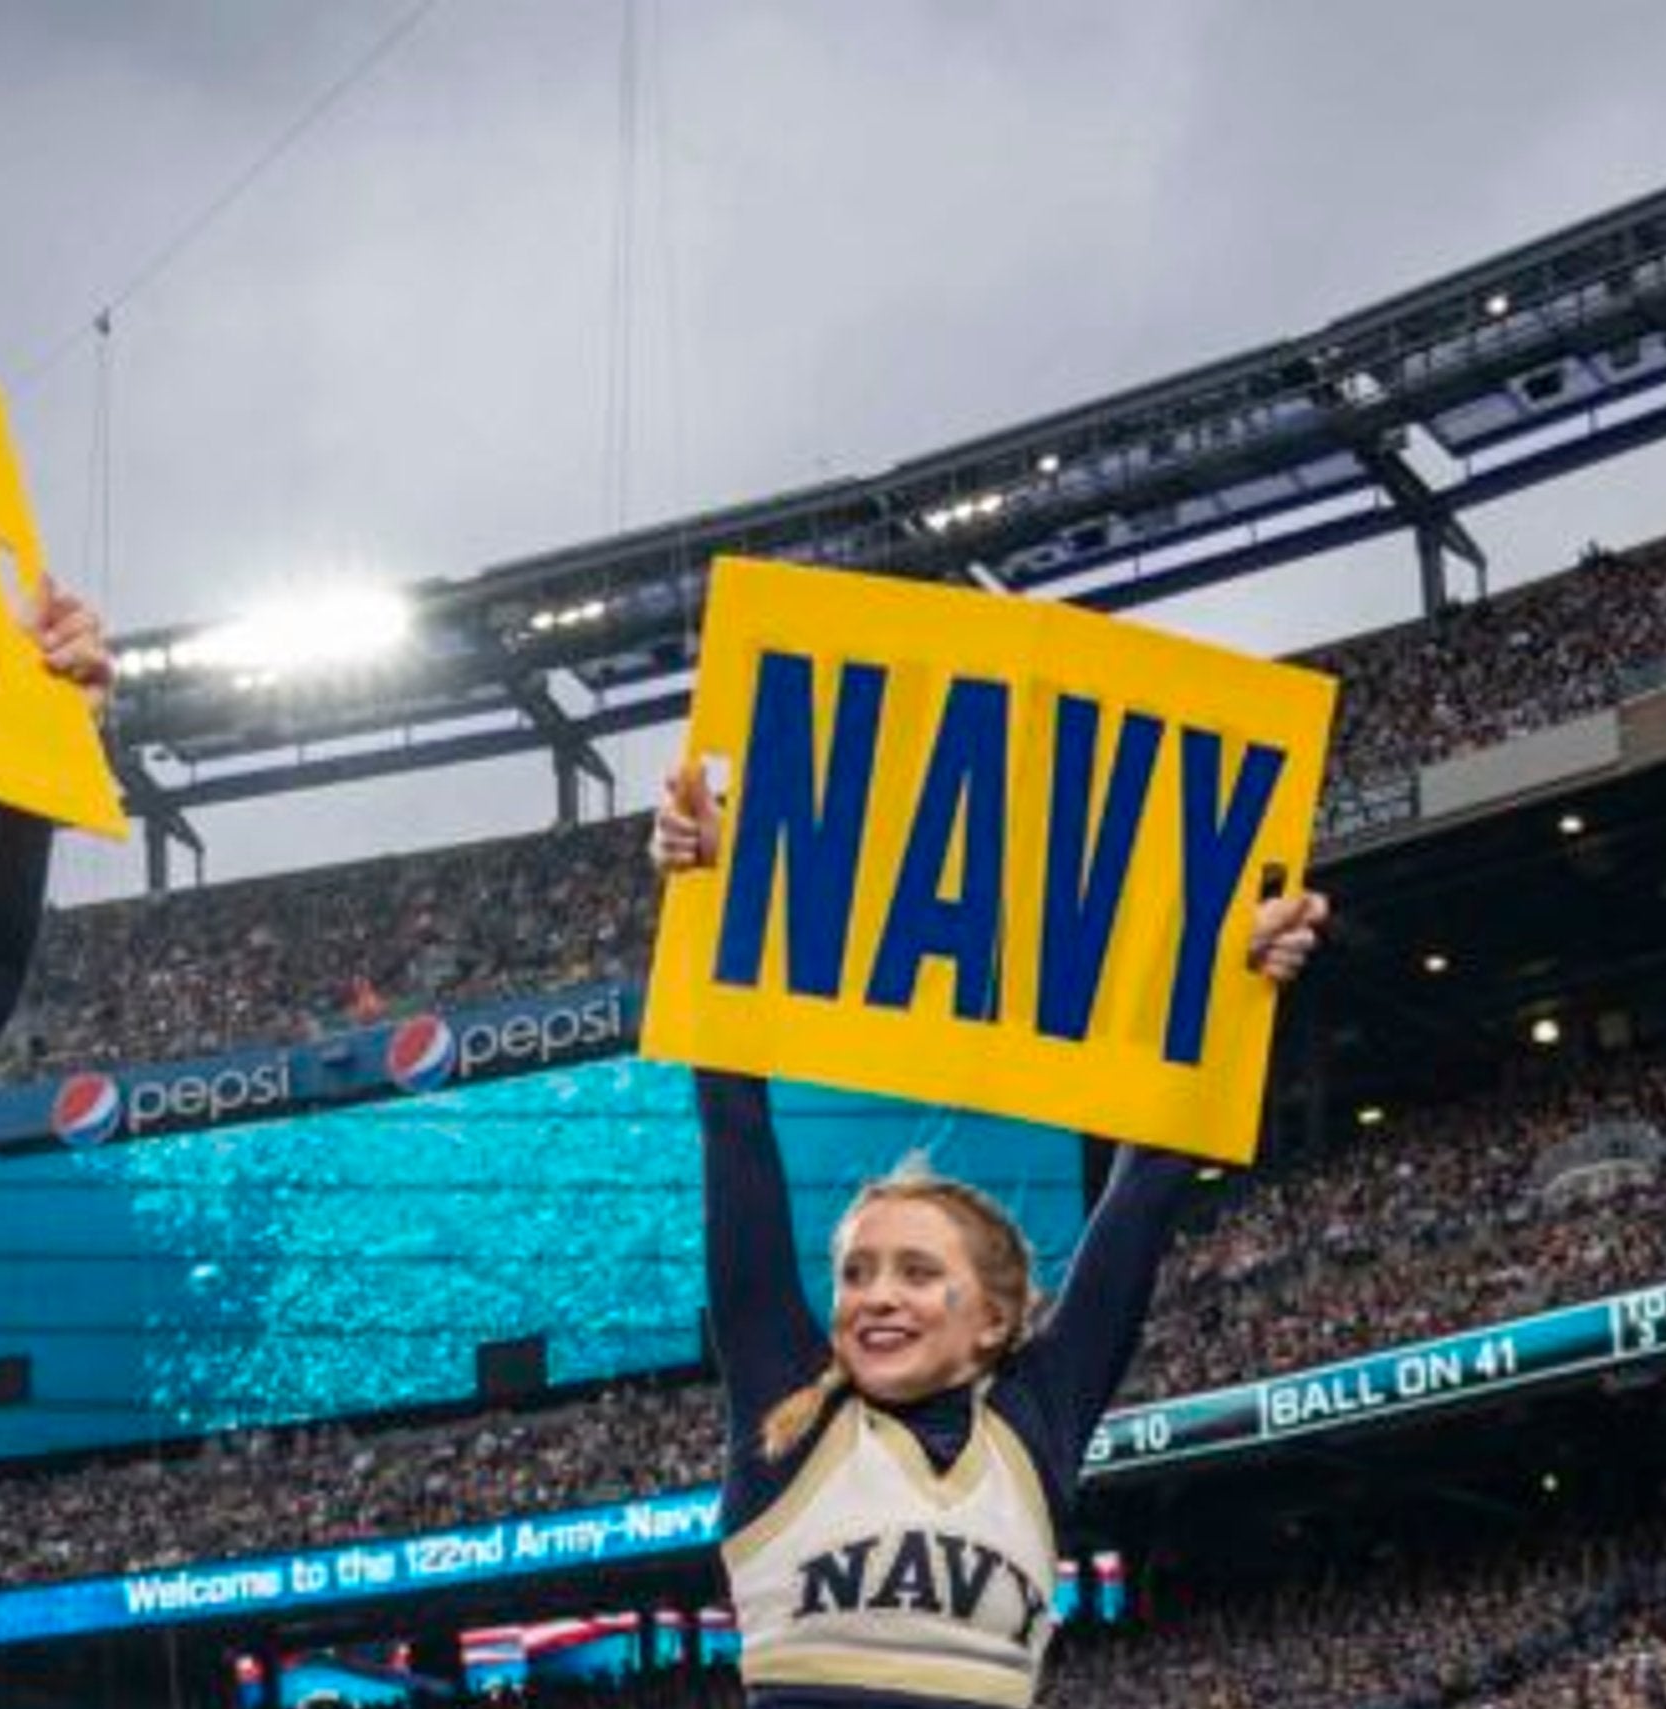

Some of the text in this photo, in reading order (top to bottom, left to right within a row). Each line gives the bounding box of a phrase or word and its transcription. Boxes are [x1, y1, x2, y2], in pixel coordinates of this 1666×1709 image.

[714, 651, 1286, 1066] NAVY
[459, 991, 621, 1075] pepsi
[130, 1054, 291, 1128] pepsi
[1638, 1320, 1656, 1348] 3
[1271, 1338, 1518, 1427] BALL ON 41
[1130, 1414, 1171, 1451] 10
[126, 1499, 722, 1614] Welcome to the 122nd Army-Navy
